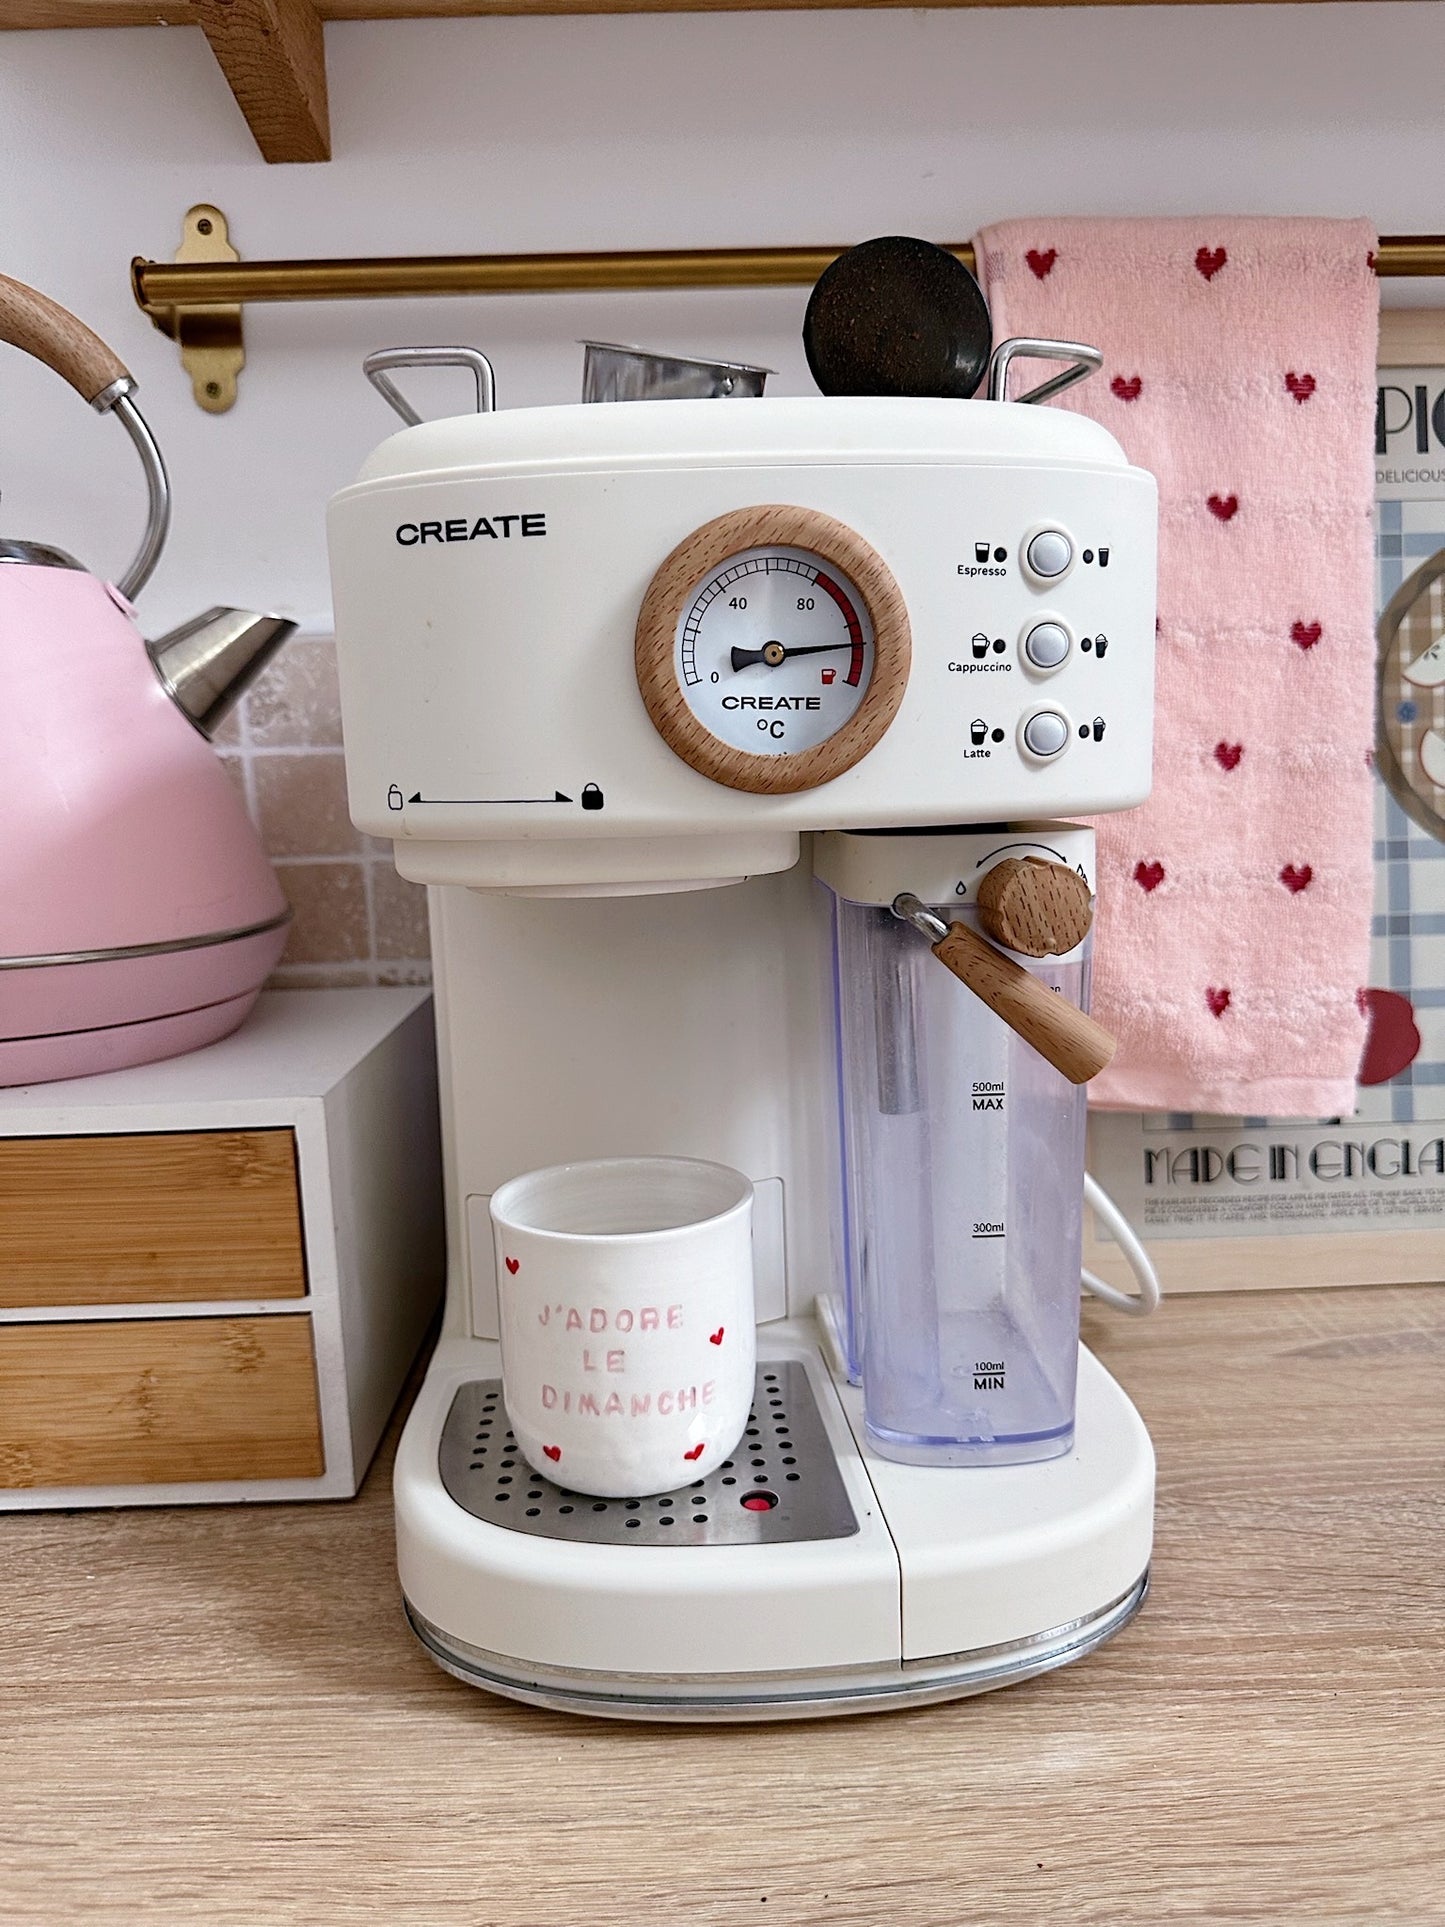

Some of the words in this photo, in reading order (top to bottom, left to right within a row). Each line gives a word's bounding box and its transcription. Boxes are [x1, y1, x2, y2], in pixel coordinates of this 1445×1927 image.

[1375, 385, 1445, 455] PI
[396, 513, 547, 546] CREATE
[957, 565, 1007, 577] Espresso
[728, 597, 748, 610] 40
[796, 597, 815, 611] 80
[948, 662, 1012, 674] Cappuccino
[710, 671, 720, 684] 0
[721, 696, 821, 711] CREATE
[756, 718, 786, 739] °C
[963, 749, 991, 759] Latte
[972, 1081, 1004, 1092] 500ml
[972, 1098, 1004, 1111] MAX
[1144, 1143, 1261, 1186] MADE
[1268, 1143, 1299, 1181] IN
[972, 1222, 1004, 1232] 300ml
[538, 1304, 683, 1334] J'ADORE
[583, 1349, 625, 1373] LE
[974, 1361, 1004, 1371] 100ml
[974, 1376, 1004, 1390] MIN
[541, 1380, 716, 1418] DIMANCHE
